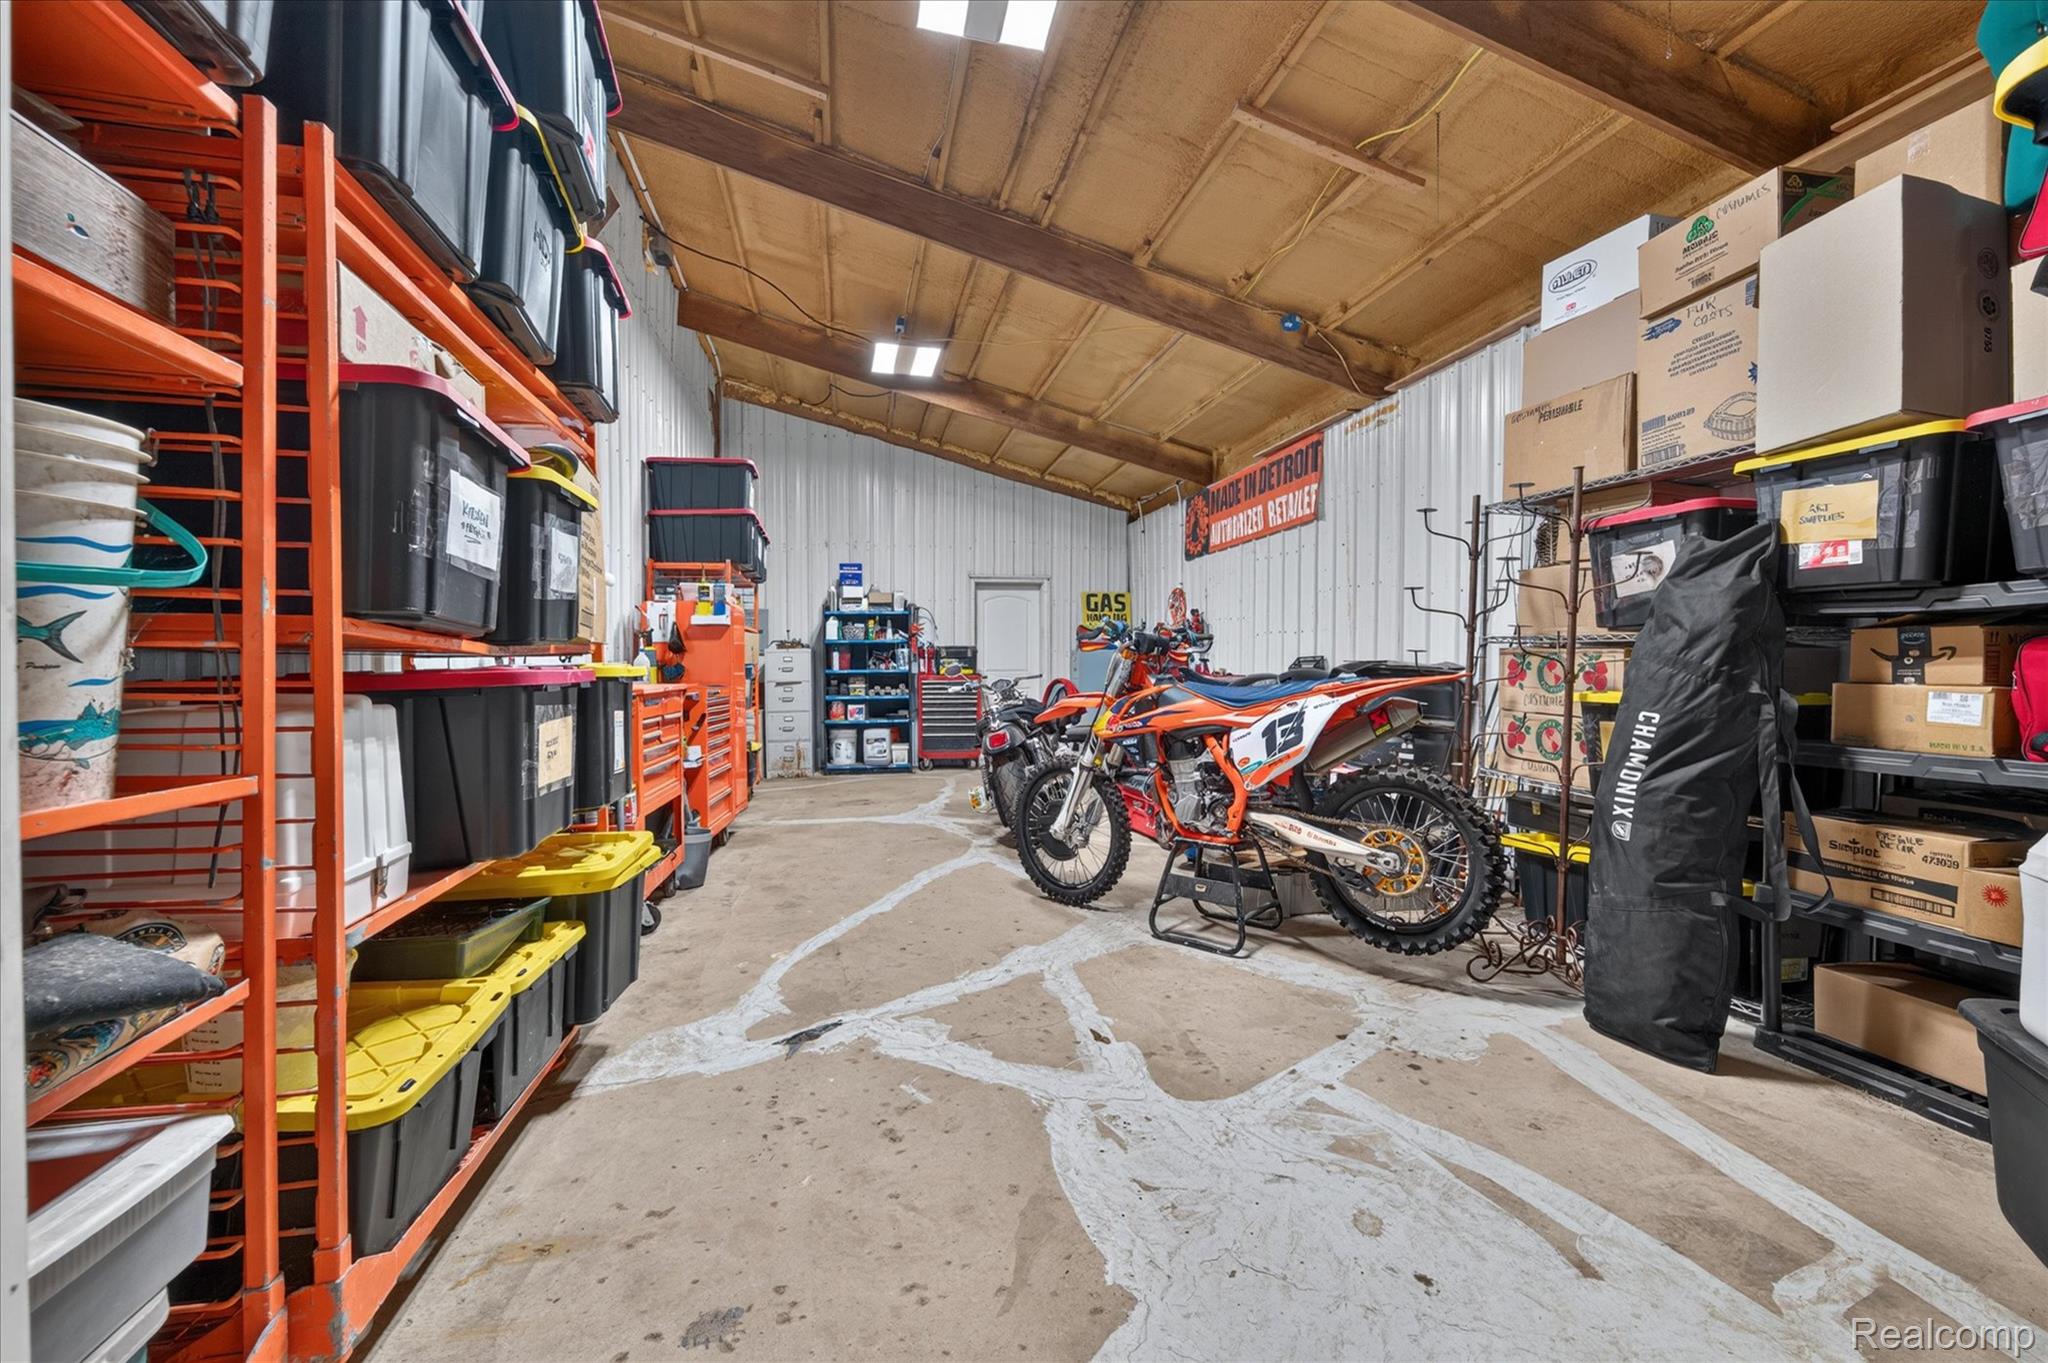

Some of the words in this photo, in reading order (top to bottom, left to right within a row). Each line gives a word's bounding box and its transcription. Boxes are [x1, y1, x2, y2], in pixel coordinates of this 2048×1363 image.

[1210, 477, 1242, 516] MADE
[1244, 469, 1258, 502] IN
[1258, 438, 1322, 495] DETROIT
[1086, 593, 1126, 612] GAS
[1261, 710, 1306, 760] 13
[1612, 710, 1661, 819] CHAMONIX
[1828, 840, 1881, 859] Simplot
